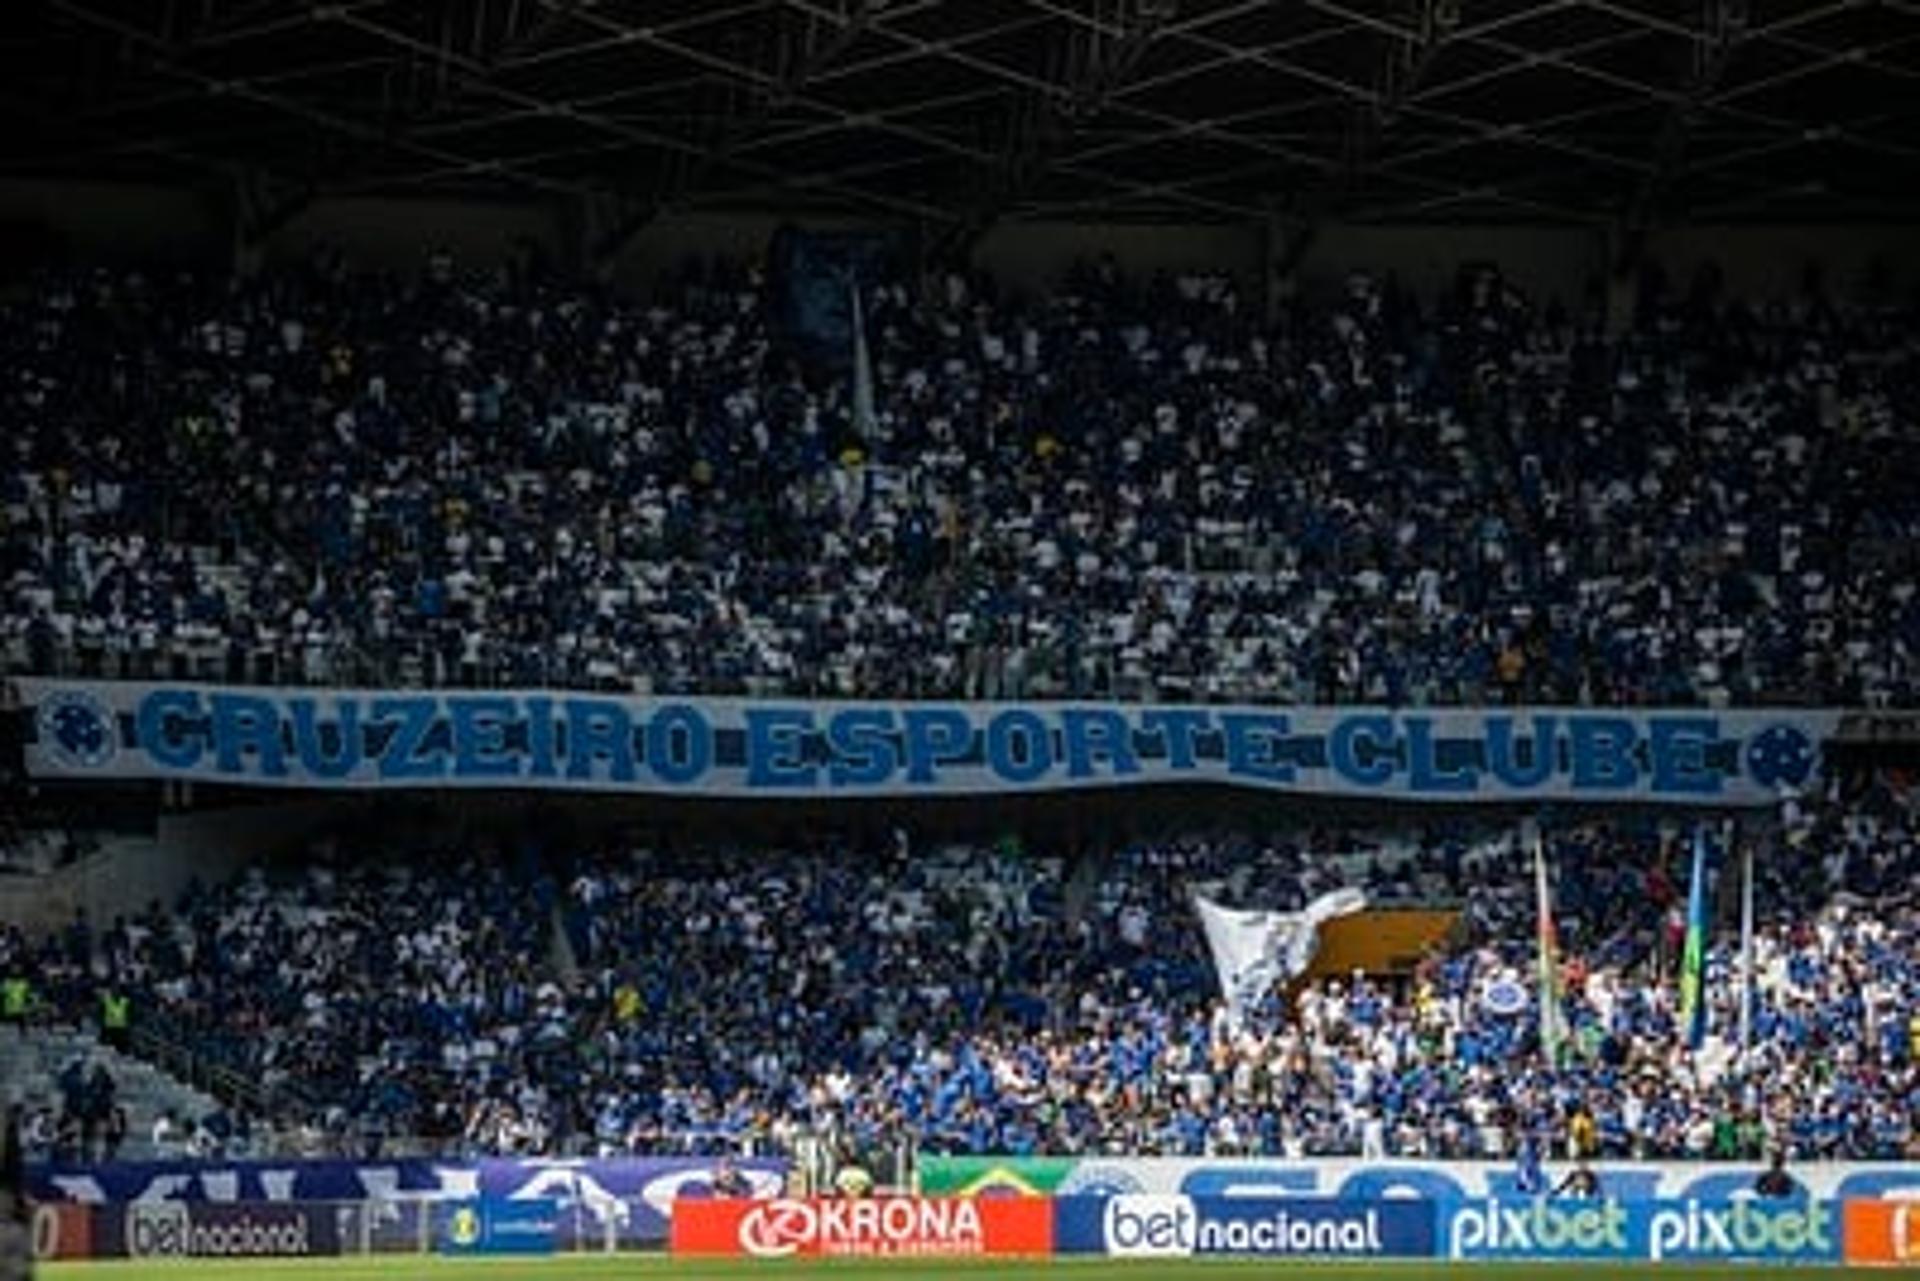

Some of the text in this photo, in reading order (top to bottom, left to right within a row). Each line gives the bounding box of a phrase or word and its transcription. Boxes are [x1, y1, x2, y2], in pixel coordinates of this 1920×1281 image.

[138, 690, 713, 783] CRUZEIRO
[746, 709, 1296, 787] ESPORTE
[1330, 715, 1722, 792] CLUBE
[820, 1199, 981, 1240] KRONA
[1452, 1198, 1626, 1256] pixbet
[1652, 1198, 1829, 1257] pixbet
